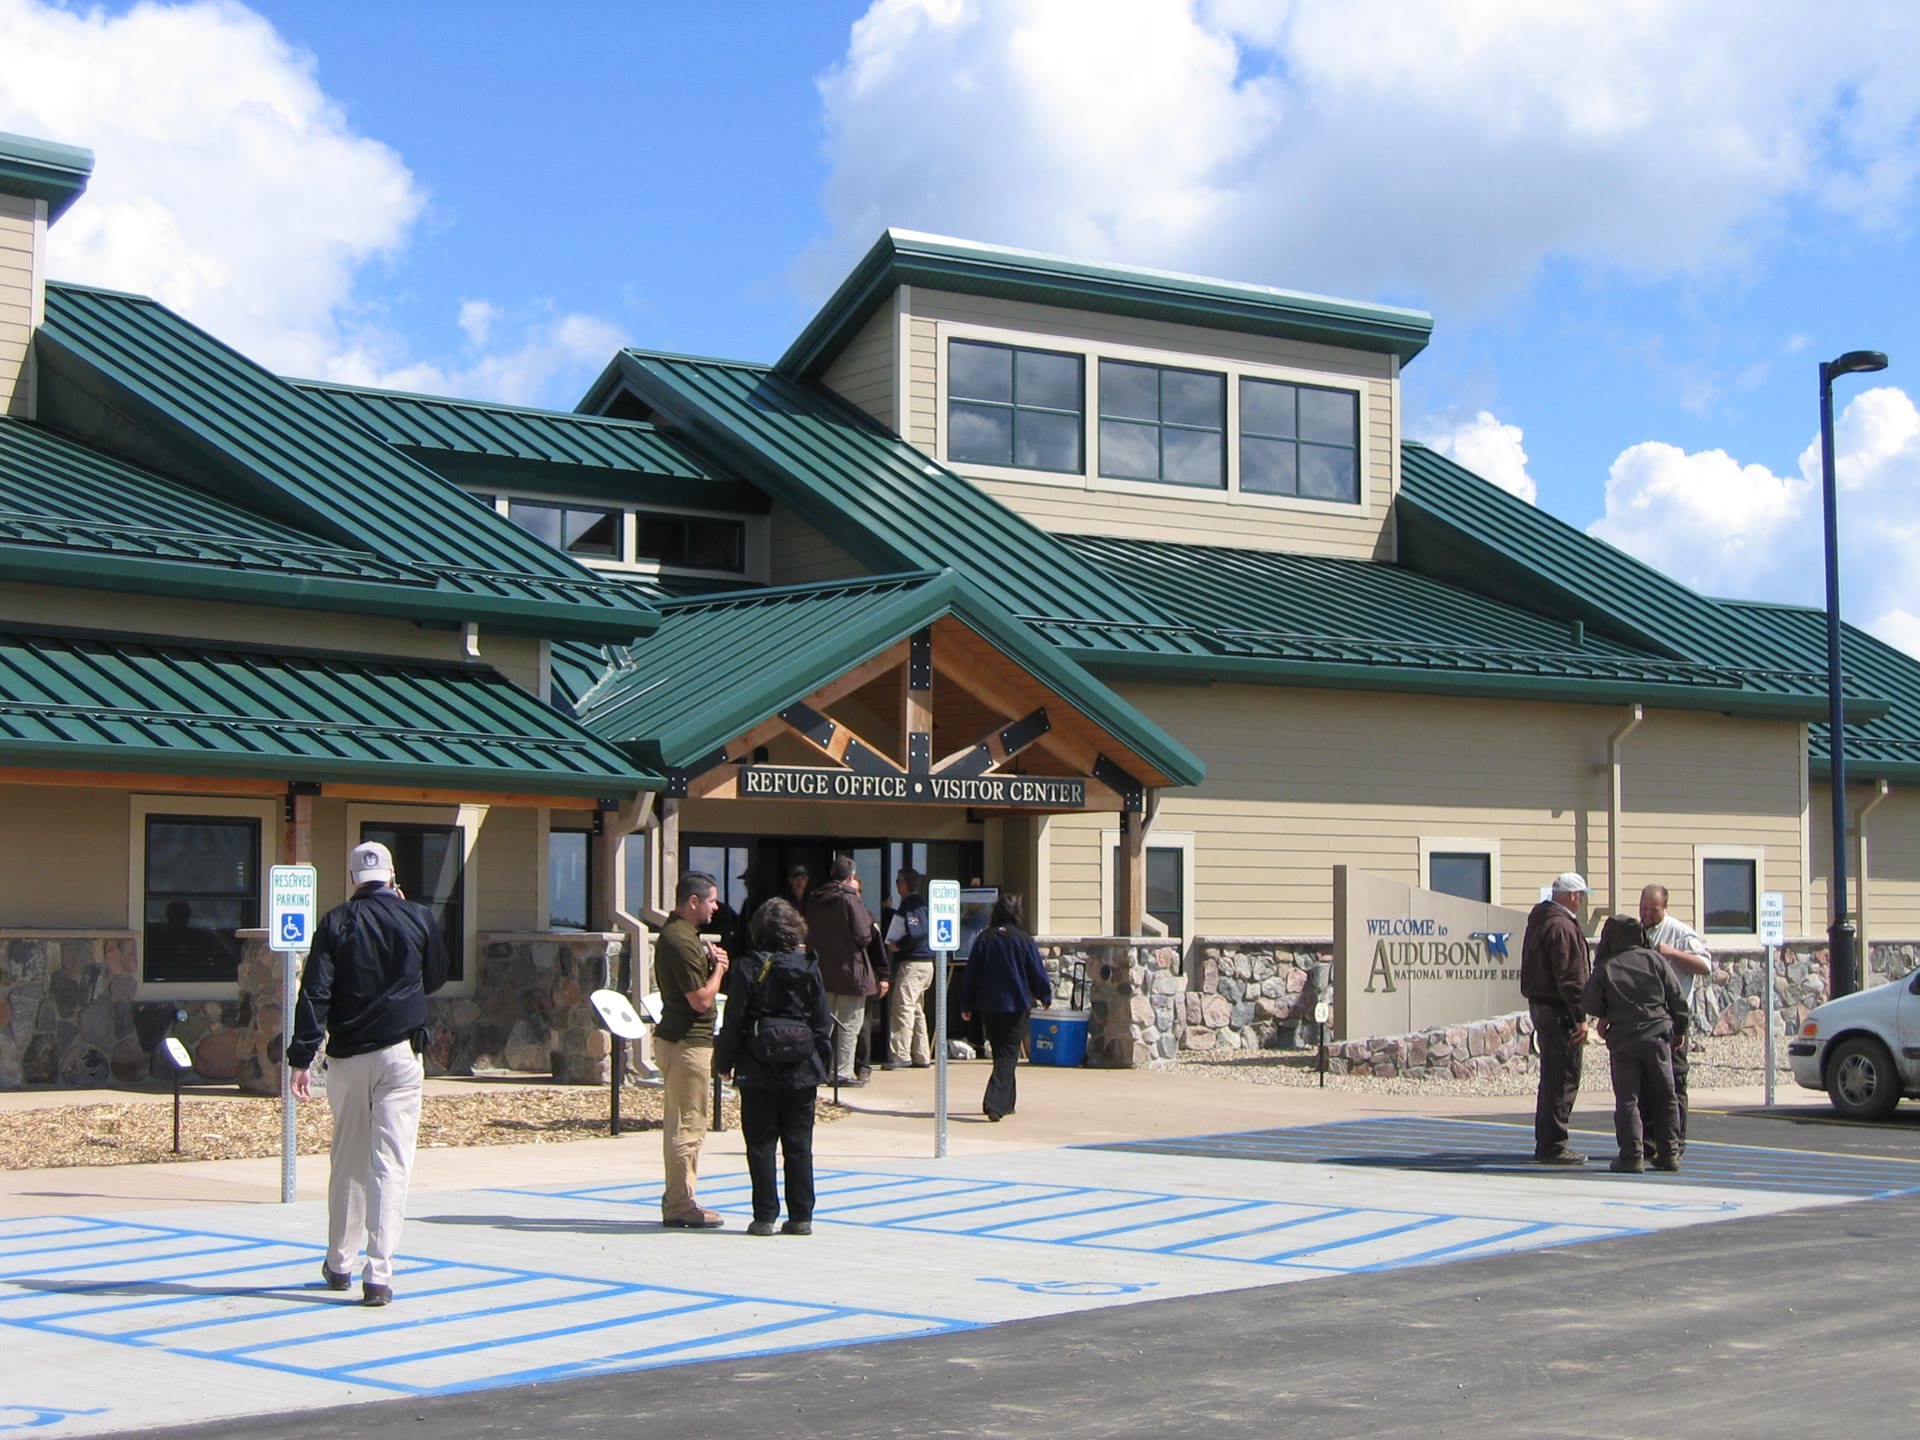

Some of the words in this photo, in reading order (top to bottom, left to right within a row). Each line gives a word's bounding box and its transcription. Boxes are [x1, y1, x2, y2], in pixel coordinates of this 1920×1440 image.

[746, 771, 829, 794] REFUGE
[834, 775, 907, 797] OFFICE
[930, 778, 1004, 800] VISITOR
[1010, 782, 1083, 802] CENTER
[275, 874, 312, 887] RESERVED
[277, 894, 310, 906] PARKING
[933, 903, 956, 913] PARKING
[1367, 919, 1435, 936] WELCOME
[1438, 924, 1448, 935] to
[1364, 938, 1482, 993] AUDUBON
[1394, 969, 1442, 980] NATIONAL
[1445, 969, 1497, 980] WILDLIFE
